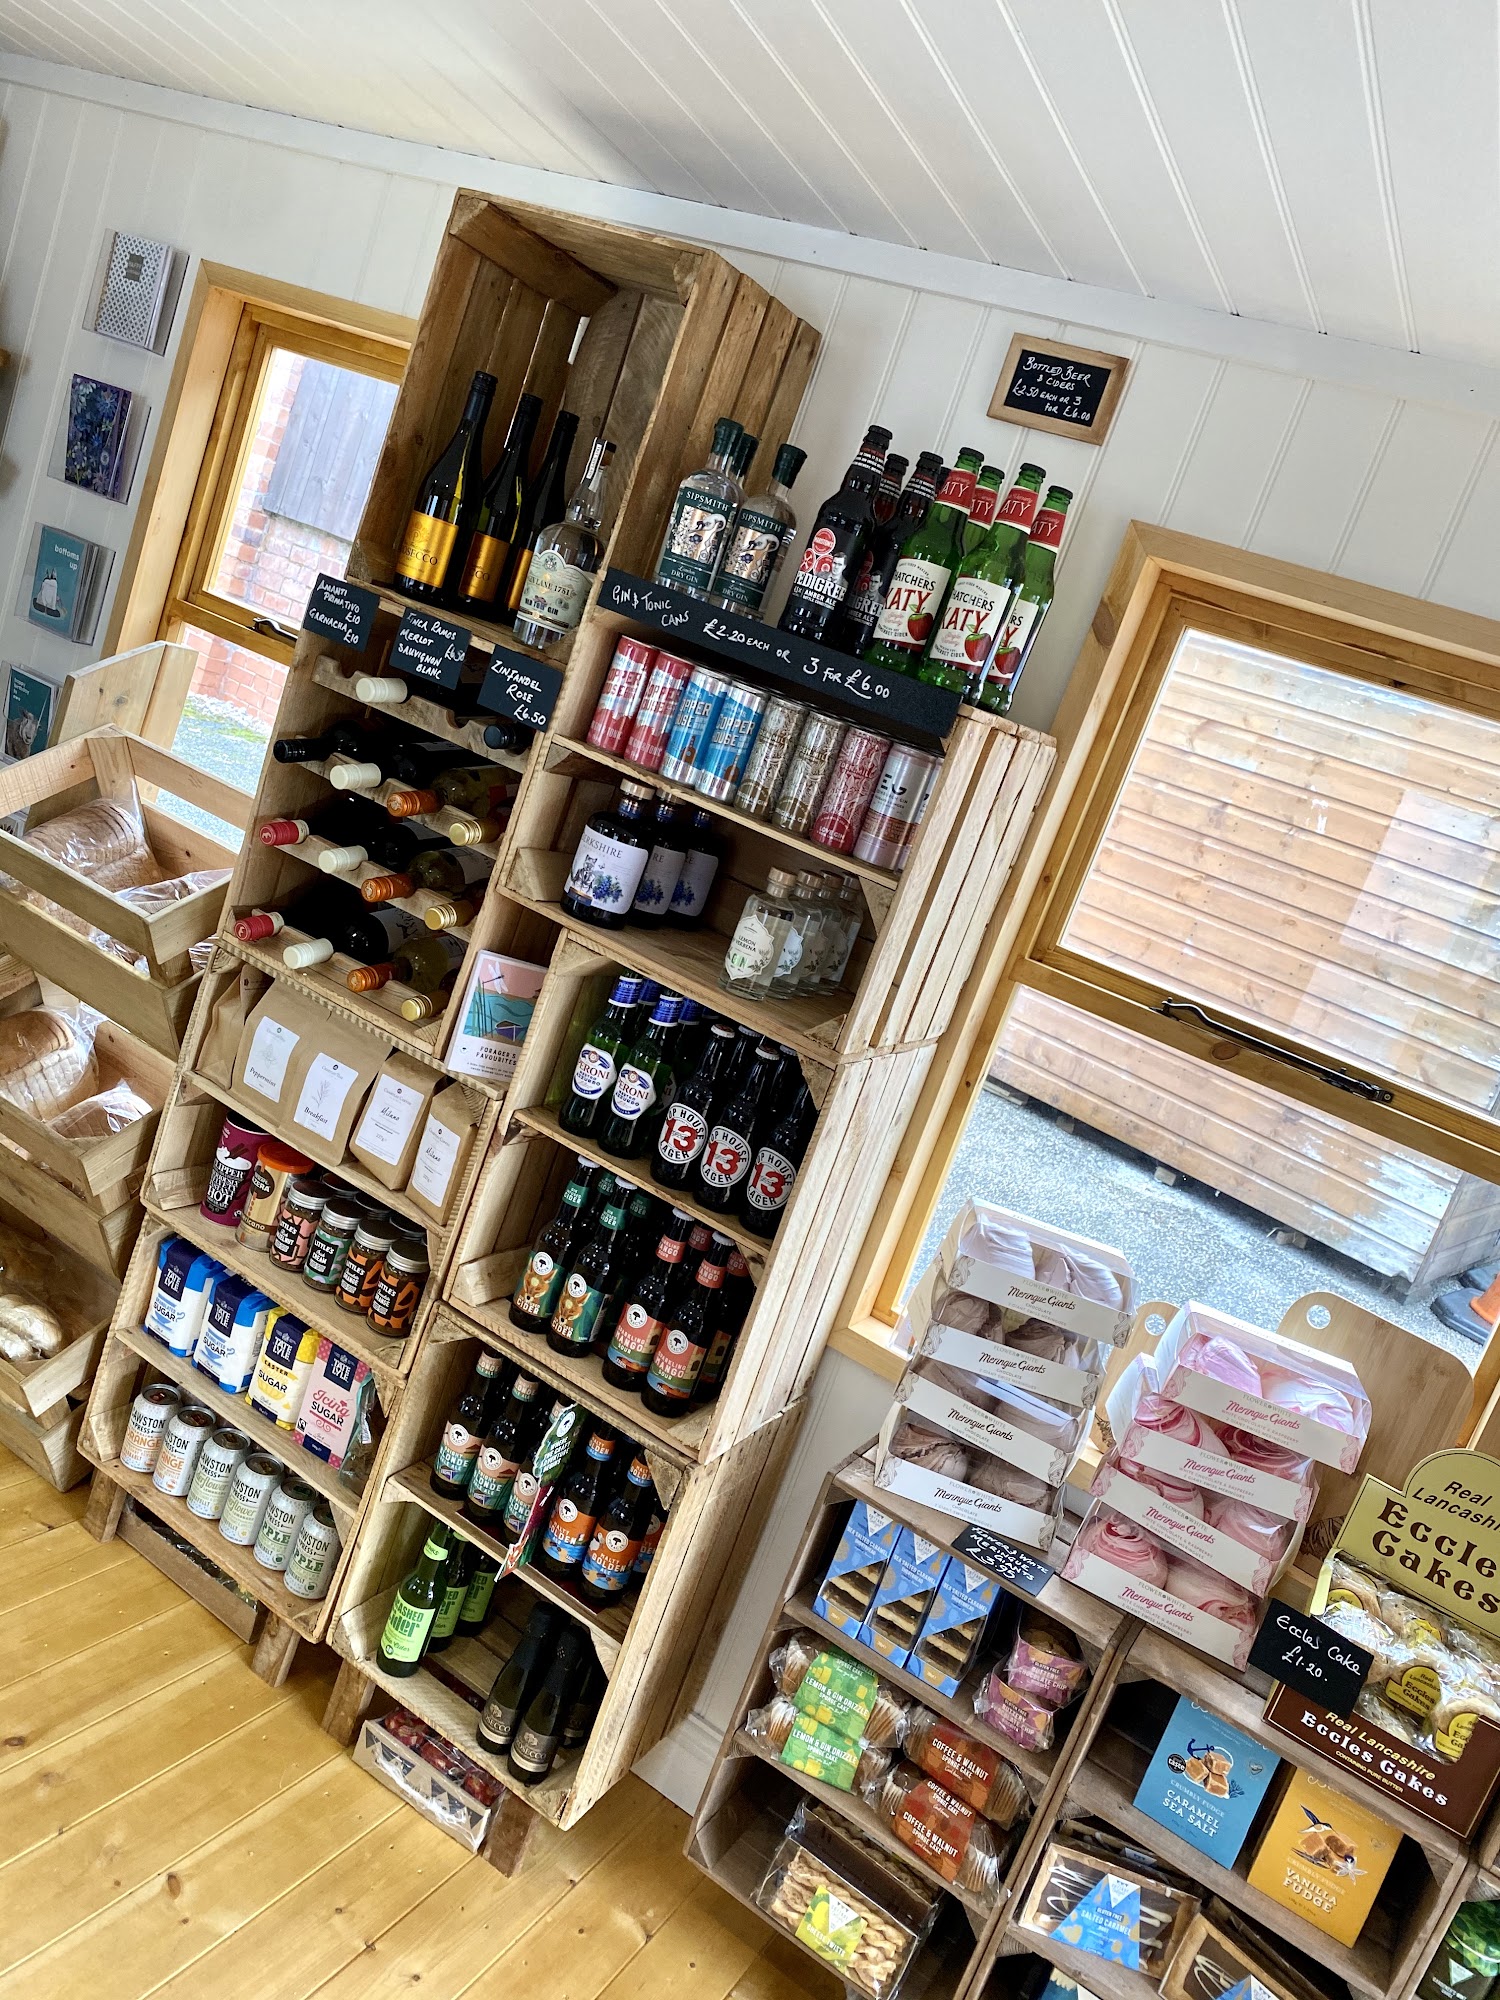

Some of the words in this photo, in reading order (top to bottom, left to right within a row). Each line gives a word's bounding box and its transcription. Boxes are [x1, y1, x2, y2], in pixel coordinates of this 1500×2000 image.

[1023, 356, 1062, 376] BOTTLED
[1061, 366, 1091, 387] BEER
[1012, 379, 1039, 398] £2.50
[1040, 391, 1056, 401] EACH
[1073, 396, 1082, 406] 3
[1046, 378, 1075, 391] CIDERS
[1044, 403, 1058, 414] FOR
[1063, 406, 1090, 420] £6.00
[686, 491, 729, 512] SIPSMITH
[741, 512, 782, 532] SIPSMITH
[54, 544, 80, 560] bottoms
[69, 562, 77, 570] up
[317, 580, 347, 597] AMANTI
[794, 571, 846, 601] PEDIGREE
[612, 585, 630, 605] GIN
[641, 592, 672, 612] TONIC
[308, 608, 347, 632] GARNACHA
[344, 629, 359, 644] £10
[345, 611, 361, 624] £10
[661, 610, 689, 628] CANS
[400, 629, 434, 646] MERLOT
[431, 621, 457, 641] RAMOS
[398, 643, 442, 667] SAUVIGNON
[702, 618, 746, 644] £2.20
[745, 637, 770, 652] EACH
[776, 648, 791, 663] OR
[803, 657, 819, 675] 3
[824, 668, 842, 684] FOR
[844, 670, 890, 699] £6.00
[416, 664, 442, 680] BLANC
[491, 659, 542, 692] ZINFANDEL
[506, 684, 534, 704] ROSE
[514, 704, 546, 726] £6.50
[738, 934, 757, 947] LEMON
[250, 1067, 276, 1087] Peppermint
[304, 1106, 328, 1124] Breakfast
[680, 1110, 704, 1140] HOUSE
[663, 1118, 697, 1152] 13
[706, 1140, 740, 1175] 13
[722, 1133, 747, 1163] HOUSE
[751, 1163, 786, 1198] 13
[768, 1155, 792, 1186] HOUSE
[208, 1186, 233, 1205] HOT
[517, 1299, 540, 1314] CIDER
[1008, 1286, 1046, 1304] Meringue
[1048, 1295, 1076, 1310] Giants
[154, 1301, 176, 1322] SUGAR
[552, 1320, 573, 1337] CIDER
[618, 1326, 645, 1345] SPARKLING
[203, 1336, 226, 1357] SUGAR
[615, 1331, 644, 1352] MANGO
[618, 1343, 632, 1355] SOUR
[264, 1360, 288, 1376] CASTER
[656, 1358, 685, 1379] MANGO
[658, 1352, 686, 1370] SPARKLING
[979, 1352, 1017, 1370] Meringue
[1018, 1361, 1046, 1374] Giants
[258, 1370, 288, 1393] SUGAR
[658, 1369, 672, 1381] SOUR
[311, 1401, 344, 1426] SUGAR
[313, 1389, 350, 1418] Icing
[1226, 1400, 1268, 1421] Meringue
[1269, 1413, 1301, 1430] Giants
[947, 1408, 985, 1431] Meringue
[986, 1423, 1014, 1441] Giants
[440, 1447, 469, 1467] BLONDE
[474, 1470, 502, 1491] BLONDE
[1184, 1458, 1224, 1477] Meringue
[1226, 1469, 1256, 1483] Giants
[934, 1487, 972, 1506] Meringue
[974, 1498, 1002, 1513] Giants
[1444, 1481, 1493, 1507] Real
[1146, 1506, 1186, 1532] Meringue
[1187, 1525, 1215, 1544] Giants
[1377, 1498, 1497, 1578] Eccle
[592, 1554, 626, 1572] GOLDEN
[600, 1553, 620, 1564] MALTY
[970, 1534, 1030, 1571] MERINGUE
[1019, 1554, 1048, 1574] WHITE
[994, 1555, 1034, 1581] GIANTS
[1372, 1530, 1500, 1613] Cakes
[1122, 1587, 1164, 1610] Meringue
[1164, 1604, 1194, 1622] Giants
[1276, 1615, 1320, 1650] Eccles
[1328, 1646, 1361, 1676] Cake
[1420, 1674, 1434, 1682] Real
[805, 1676, 827, 1693] LEMON
[832, 1690, 843, 1702] GIN
[843, 1698, 869, 1717] DRIZZLE
[819, 1692, 837, 1706] SPONGE
[837, 1701, 850, 1713] CAKE
[1403, 1688, 1430, 1710] Cakes
[1405, 1681, 1435, 1704] Eccles
[793, 1729, 815, 1746] LEMON
[820, 1742, 831, 1753] GIN
[832, 1749, 858, 1766] DRIZZLE
[807, 1744, 826, 1758] SPONGE
[825, 1752, 838, 1762] CAKE
[1300, 1710, 1374, 1763] Eccles
[1380, 1760, 1448, 1806] Cakes
[1325, 1712, 1359, 1735] Real
[1358, 1732, 1436, 1780] Lancashire
[932, 1738, 956, 1759] COFFEE
[962, 1757, 989, 1781] WALNUT
[942, 1755, 960, 1771] SPONGE
[960, 1766, 973, 1779] CAKE
[1168, 1758, 1185, 1771] taste
[1335, 1750, 1367, 1772] CONTAINING
[1367, 1768, 1382, 1780] PURE
[1382, 1778, 1404, 1793] BUTTER
[927, 1780, 946, 1798] COFFEE
[950, 1796, 972, 1818] WALNUT
[932, 1792, 947, 1808] SPONGE
[947, 1804, 960, 1816] CAKE
[1167, 1790, 1219, 1829] CARAMEL
[1170, 1779, 1200, 1802] CRUMBLY
[1202, 1798, 1225, 1818] FUDGE
[1163, 1798, 1184, 1817] SEA
[1188, 1815, 1216, 1838] SALT
[903, 1812, 926, 1833] COFFEE
[932, 1832, 958, 1858] WALNUT
[912, 1828, 930, 1846] SPONGE
[929, 1841, 943, 1855] CAKE
[1283, 1877, 1333, 1914] FUDGE
[1287, 1867, 1337, 1906] VANILLA
[1081, 1910, 1103, 1924] SALTED
[1104, 1919, 1131, 1936] CARAMEL
